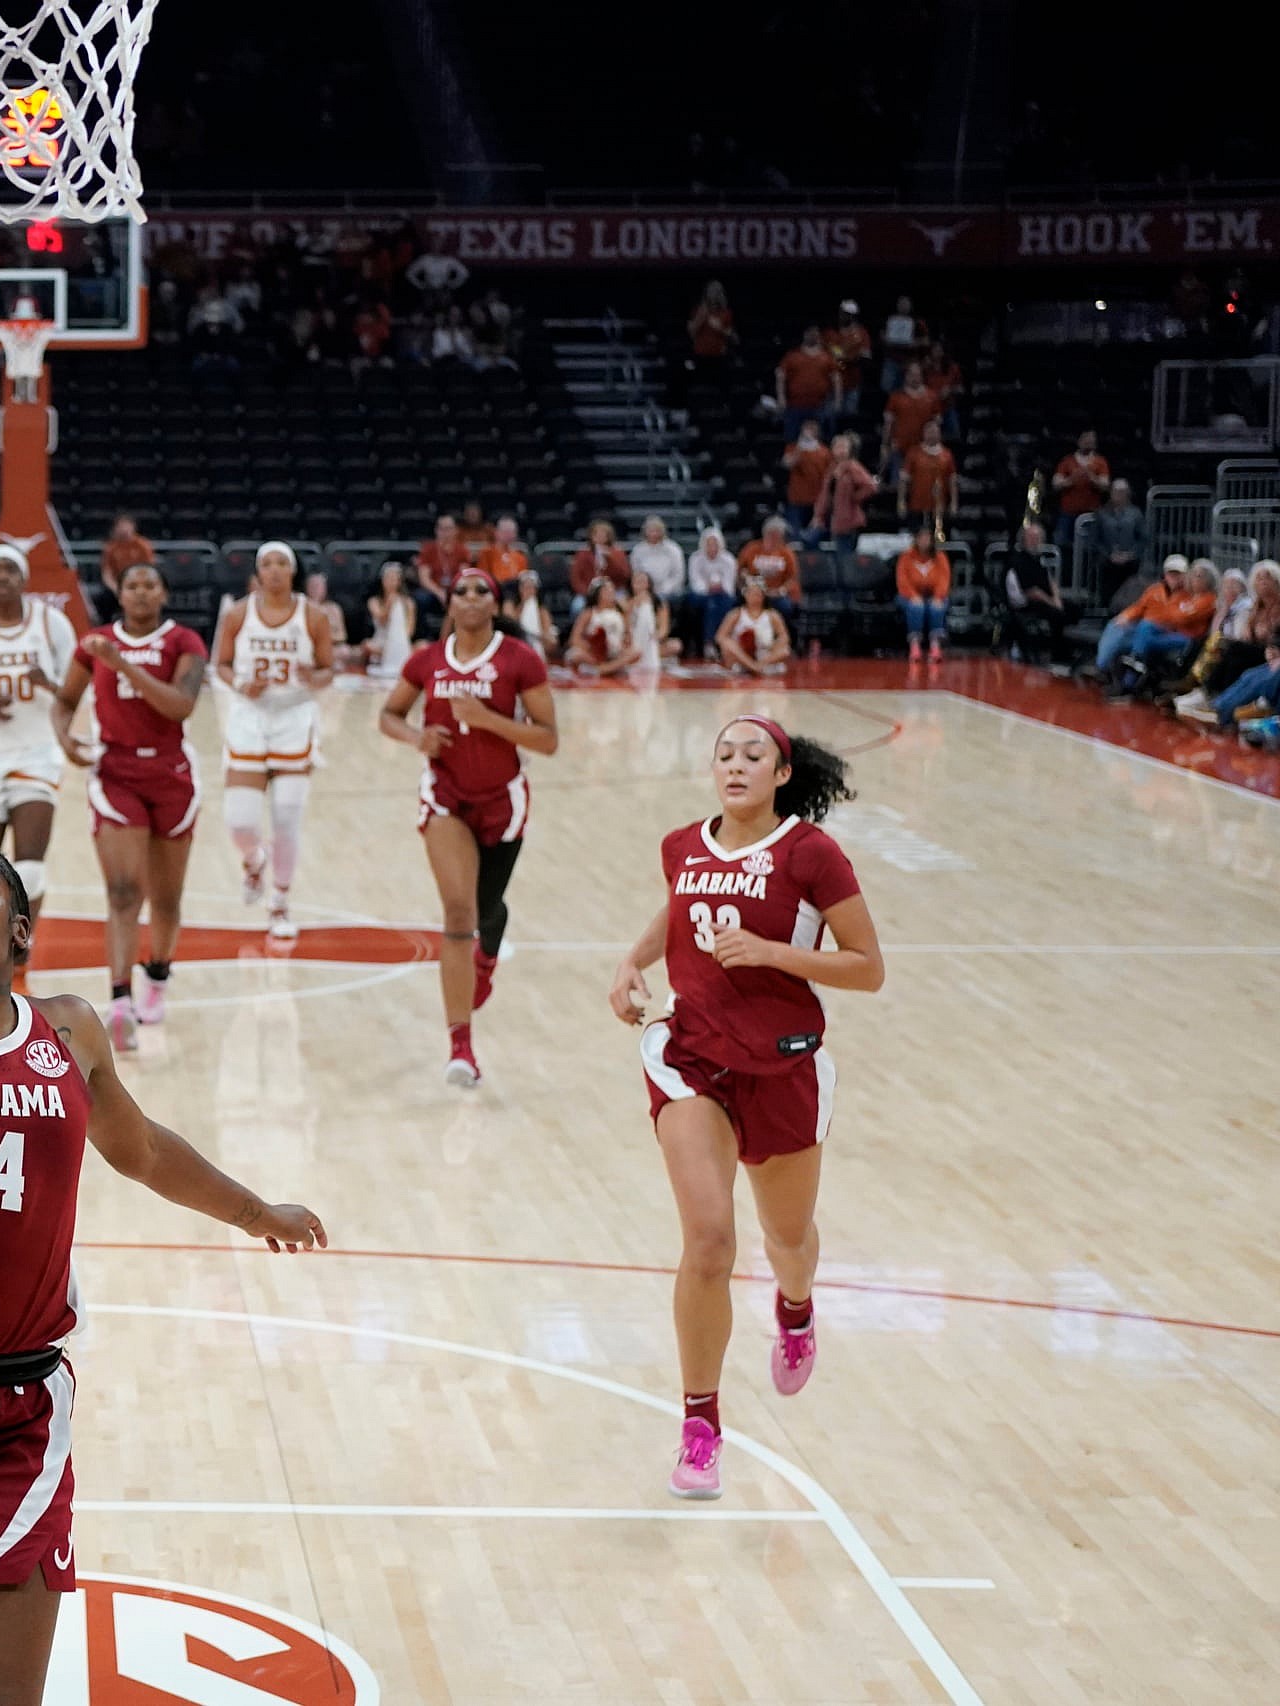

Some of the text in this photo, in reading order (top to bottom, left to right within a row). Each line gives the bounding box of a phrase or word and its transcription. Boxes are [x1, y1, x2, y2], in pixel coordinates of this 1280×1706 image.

[425, 219, 576, 258] TEXAS
[589, 218, 858, 258] LONGHORNS
[1017, 215, 1153, 255] HOOK
[255, 657, 289, 684] 23
[675, 871, 766, 900] ALABAMA
[28, 1041, 60, 1069] SEC
